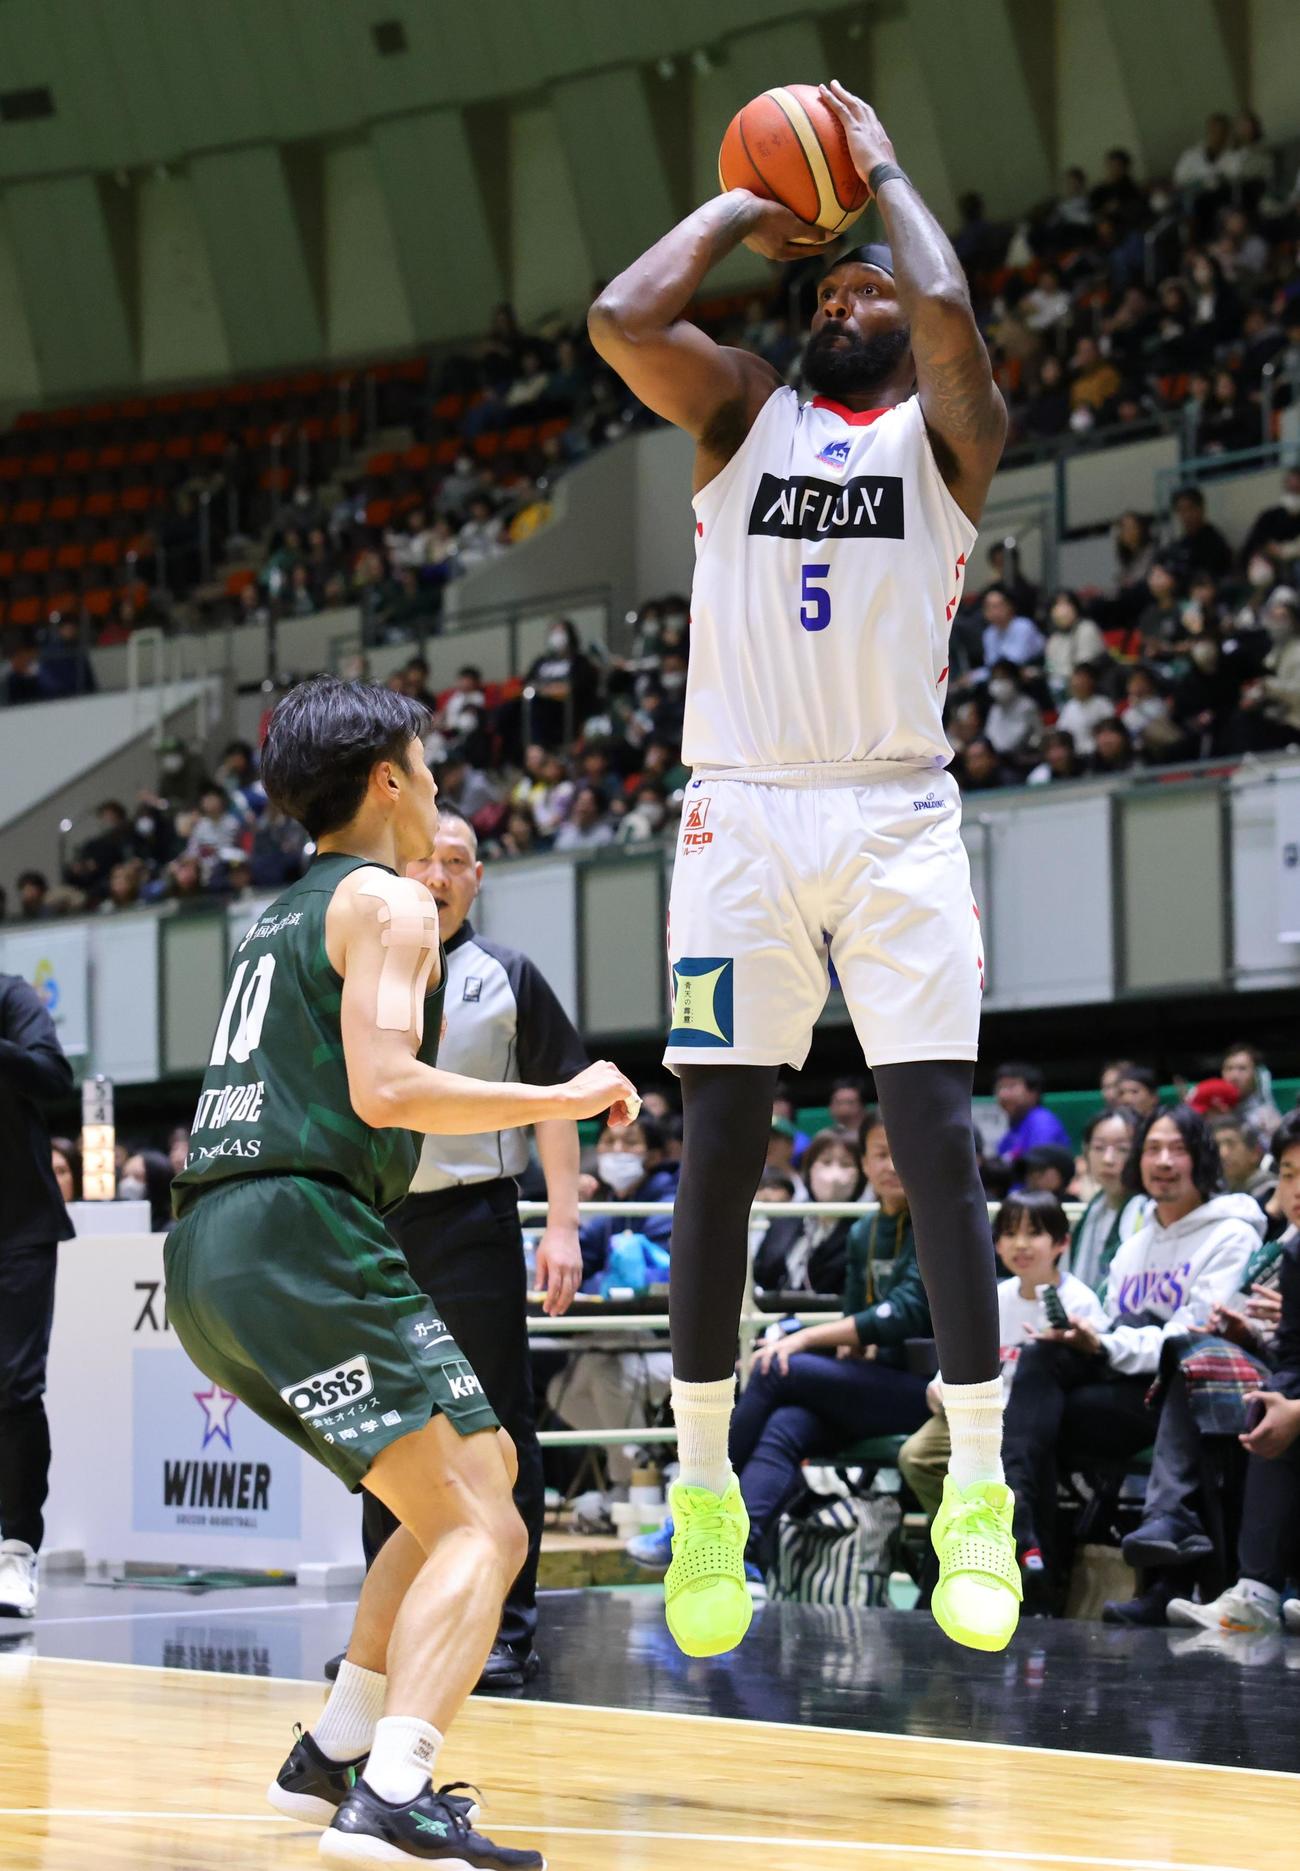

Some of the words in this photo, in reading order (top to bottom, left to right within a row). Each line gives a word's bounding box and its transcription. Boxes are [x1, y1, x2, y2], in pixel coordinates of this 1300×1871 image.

[800, 564, 831, 631] 5
[209, 952, 276, 1067] 10
[133, 1281, 170, 1331] ス
[288, 1368, 365, 1414] Oisis
[308, 1396, 381, 1429] 会社オイシス
[164, 1459, 271, 1511] WINNER
